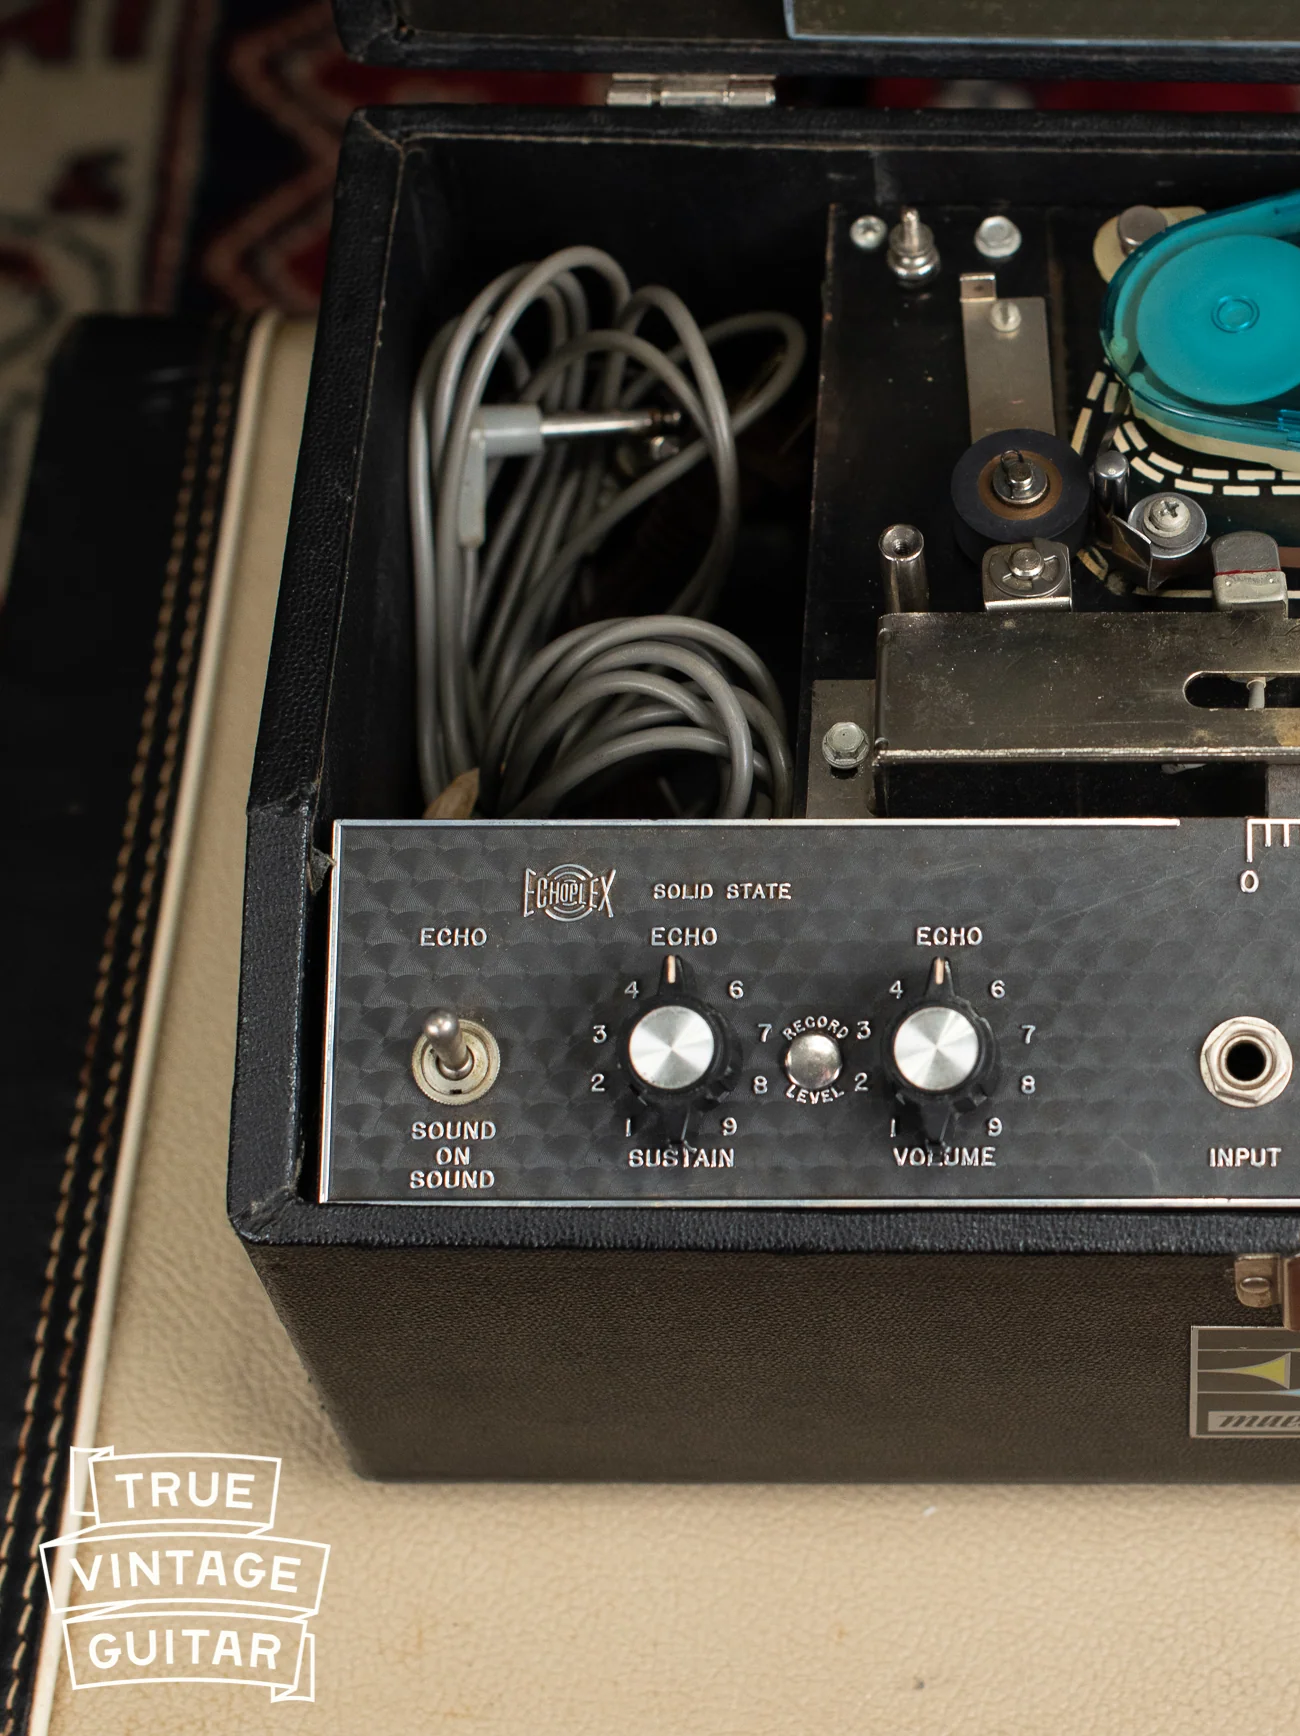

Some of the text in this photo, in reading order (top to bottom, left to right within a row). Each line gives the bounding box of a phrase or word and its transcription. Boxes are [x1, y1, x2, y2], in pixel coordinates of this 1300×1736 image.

[522, 866, 617, 921] ECHOPLEX
[653, 882, 792, 900] SOLID STATE
[420, 927, 488, 947] ECHO
[651, 926, 718, 947] ECHO
[916, 926, 983, 947] ECHO
[624, 980, 639, 999] 4
[729, 980, 744, 1000] 6
[889, 979, 903, 1000] 4
[991, 979, 1006, 999] 6
[592, 1024, 607, 1044] 3
[758, 1023, 772, 1043] 7
[782, 1015, 849, 1040] RECORD
[856, 1020, 871, 1040] 3
[1021, 1024, 1036, 1045] 7
[590, 1073, 605, 1092] 2
[753, 1075, 768, 1094] 8
[854, 1072, 868, 1092] 2
[1021, 1075, 1036, 1094] 8
[785, 1084, 845, 1105] LEVEL
[411, 1120, 497, 1140] SOUND
[722, 1117, 738, 1137] 9
[988, 1117, 1003, 1137] 9
[436, 1146, 470, 1166] ON
[628, 1147, 735, 1168] SUSTAIN
[893, 1146, 997, 1167] VOLUME
[1208, 1147, 1282, 1168] INPUT
[409, 1169, 495, 1189] SOUND
